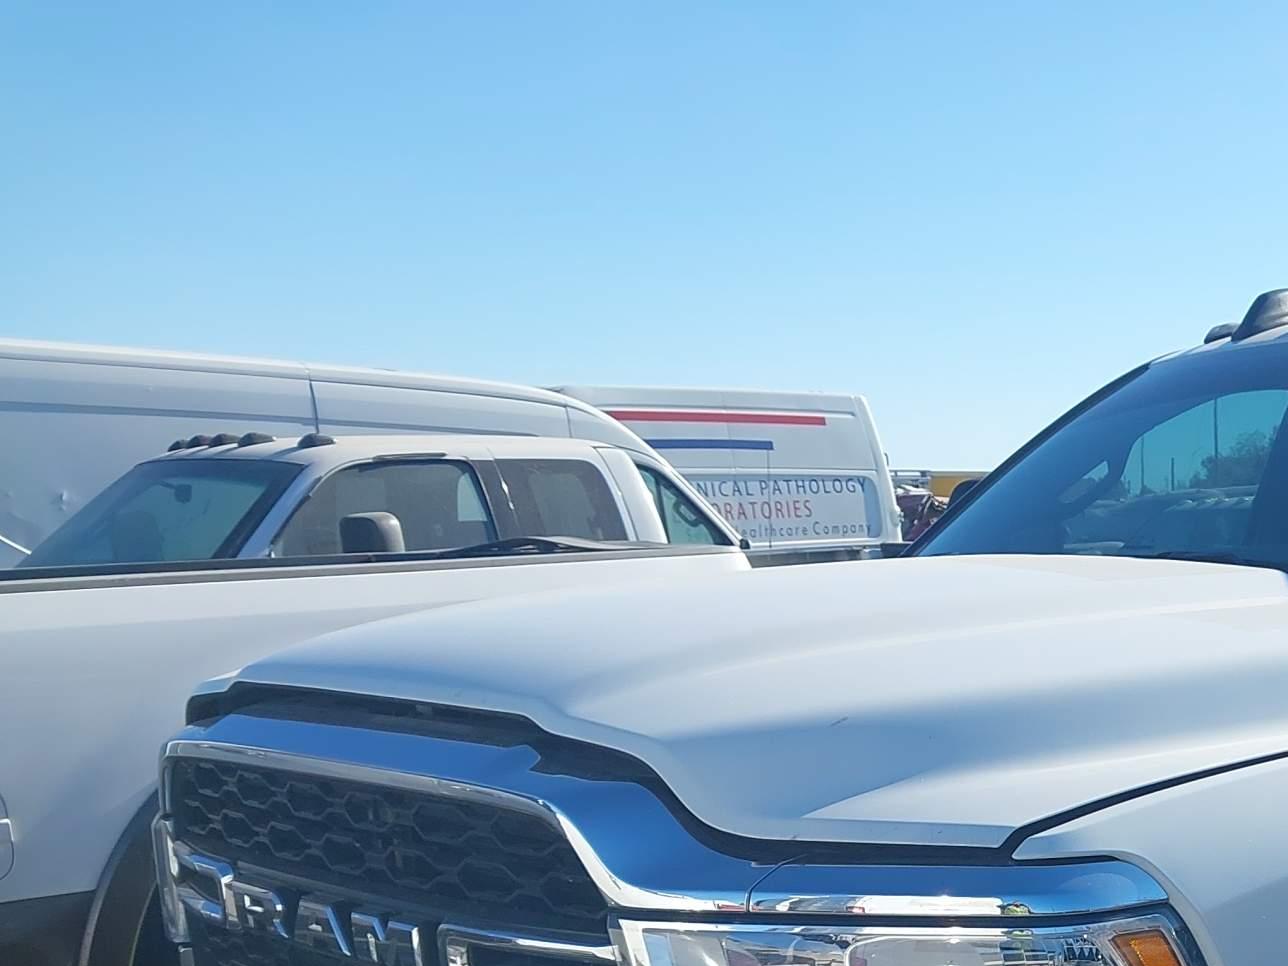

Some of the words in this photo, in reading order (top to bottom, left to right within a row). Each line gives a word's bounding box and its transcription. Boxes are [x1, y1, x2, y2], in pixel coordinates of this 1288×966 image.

[760, 477, 867, 496] PATHOLOGY
[735, 522, 808, 539] ealthcare
[812, 521, 872, 538] Company
